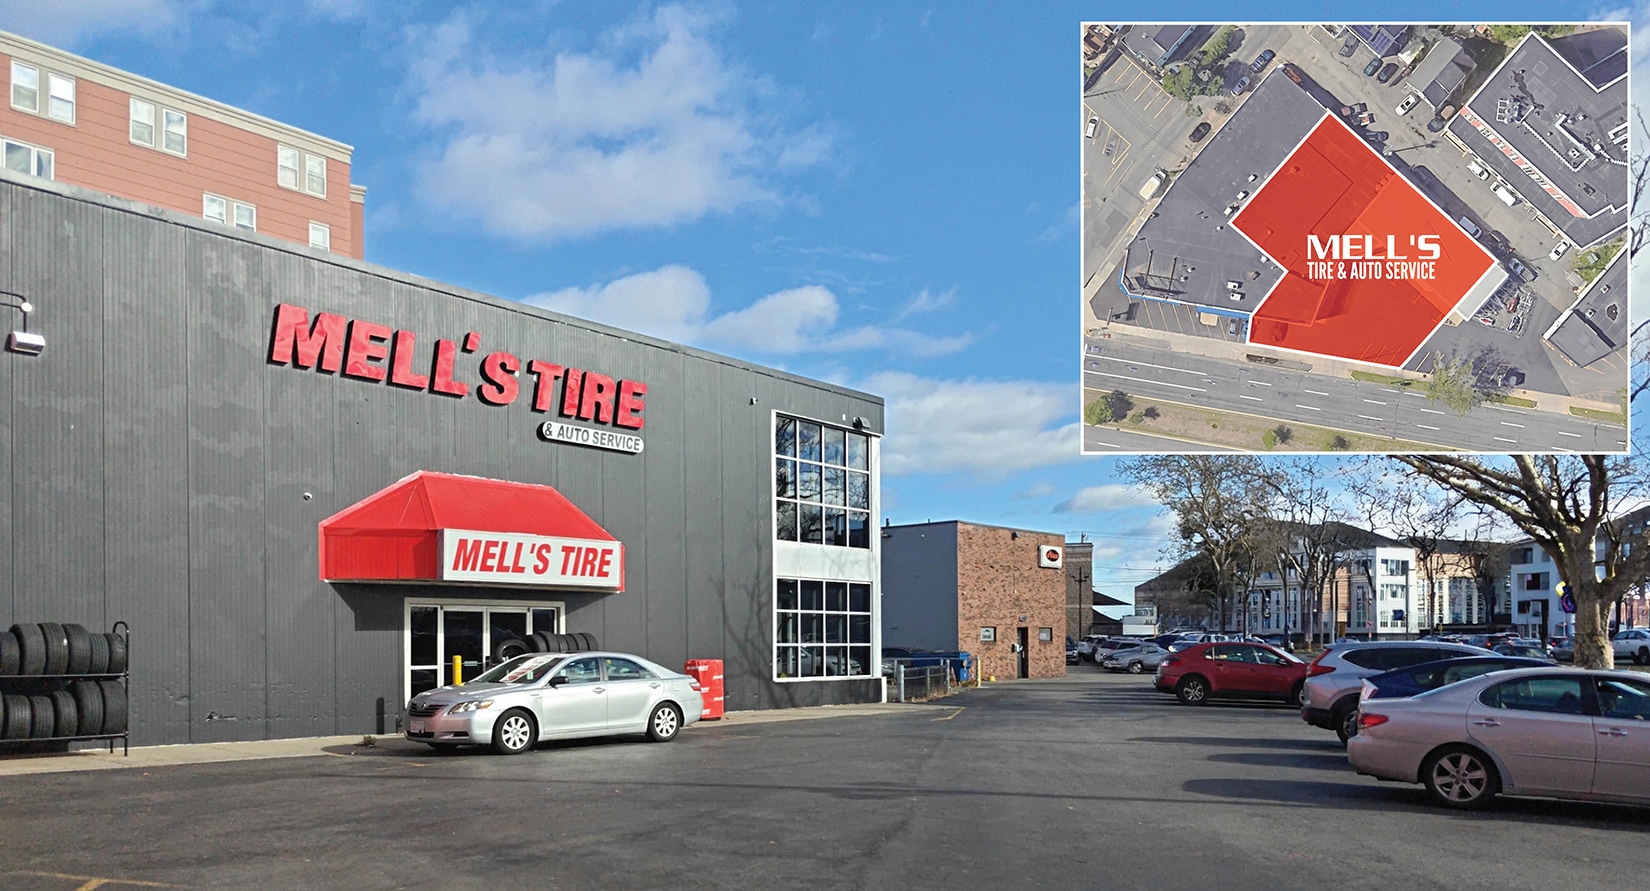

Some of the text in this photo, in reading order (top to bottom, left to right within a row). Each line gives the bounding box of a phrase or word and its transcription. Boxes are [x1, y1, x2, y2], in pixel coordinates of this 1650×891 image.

[270, 303, 648, 429] MELL'S TIRE
[544, 422, 641, 451] & AUTO SERVICE
[452, 538, 614, 578] MELL'S TIRE
